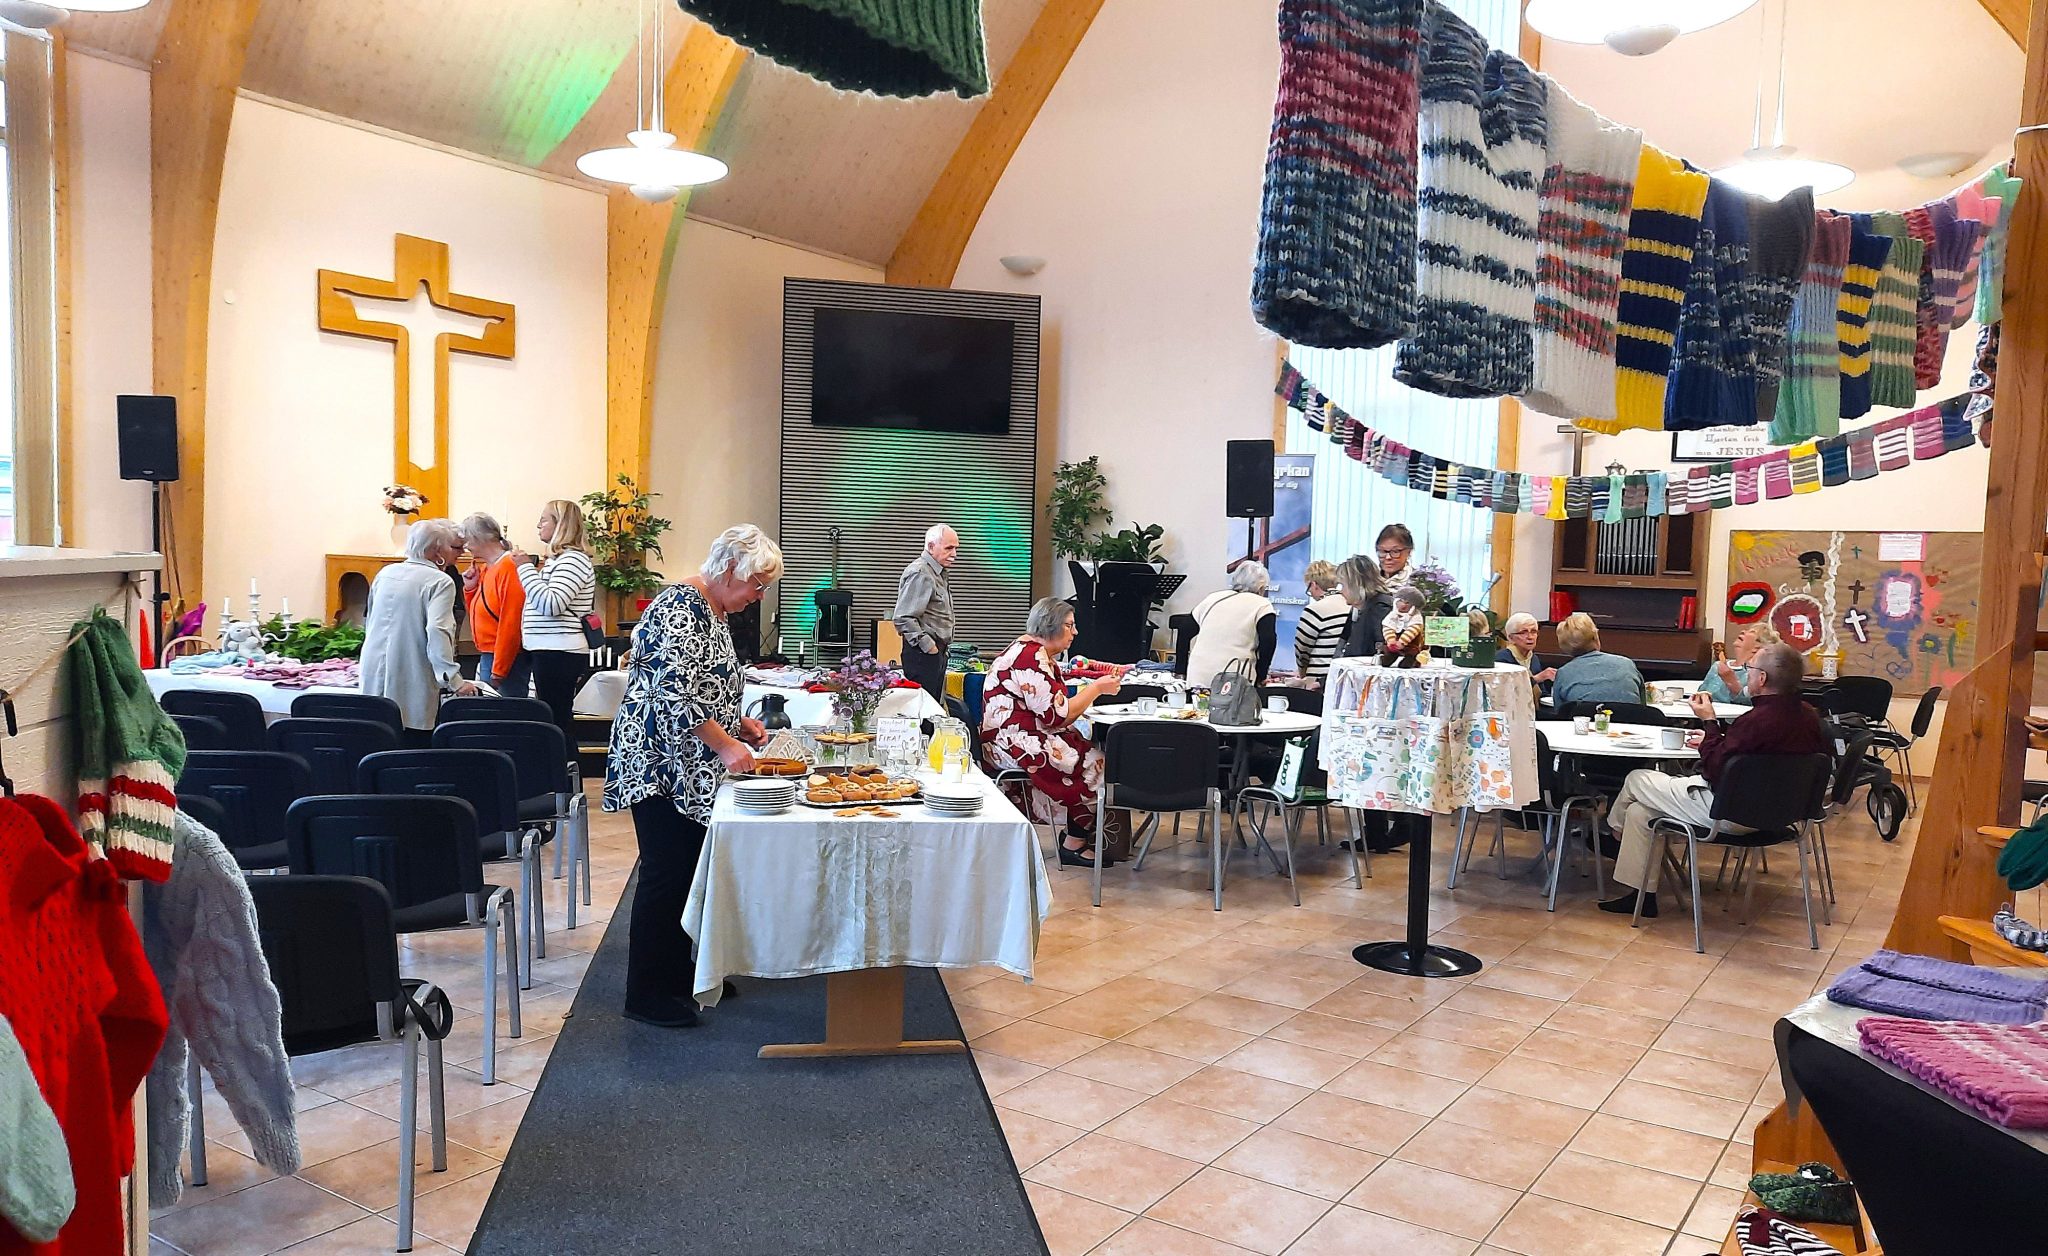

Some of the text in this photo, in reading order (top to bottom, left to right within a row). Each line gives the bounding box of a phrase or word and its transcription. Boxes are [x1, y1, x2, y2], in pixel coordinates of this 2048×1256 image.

[1716, 447, 1765, 456] JESUS
[1779, 582, 1811, 595] Gud
[1281, 753, 1291, 786] coop
